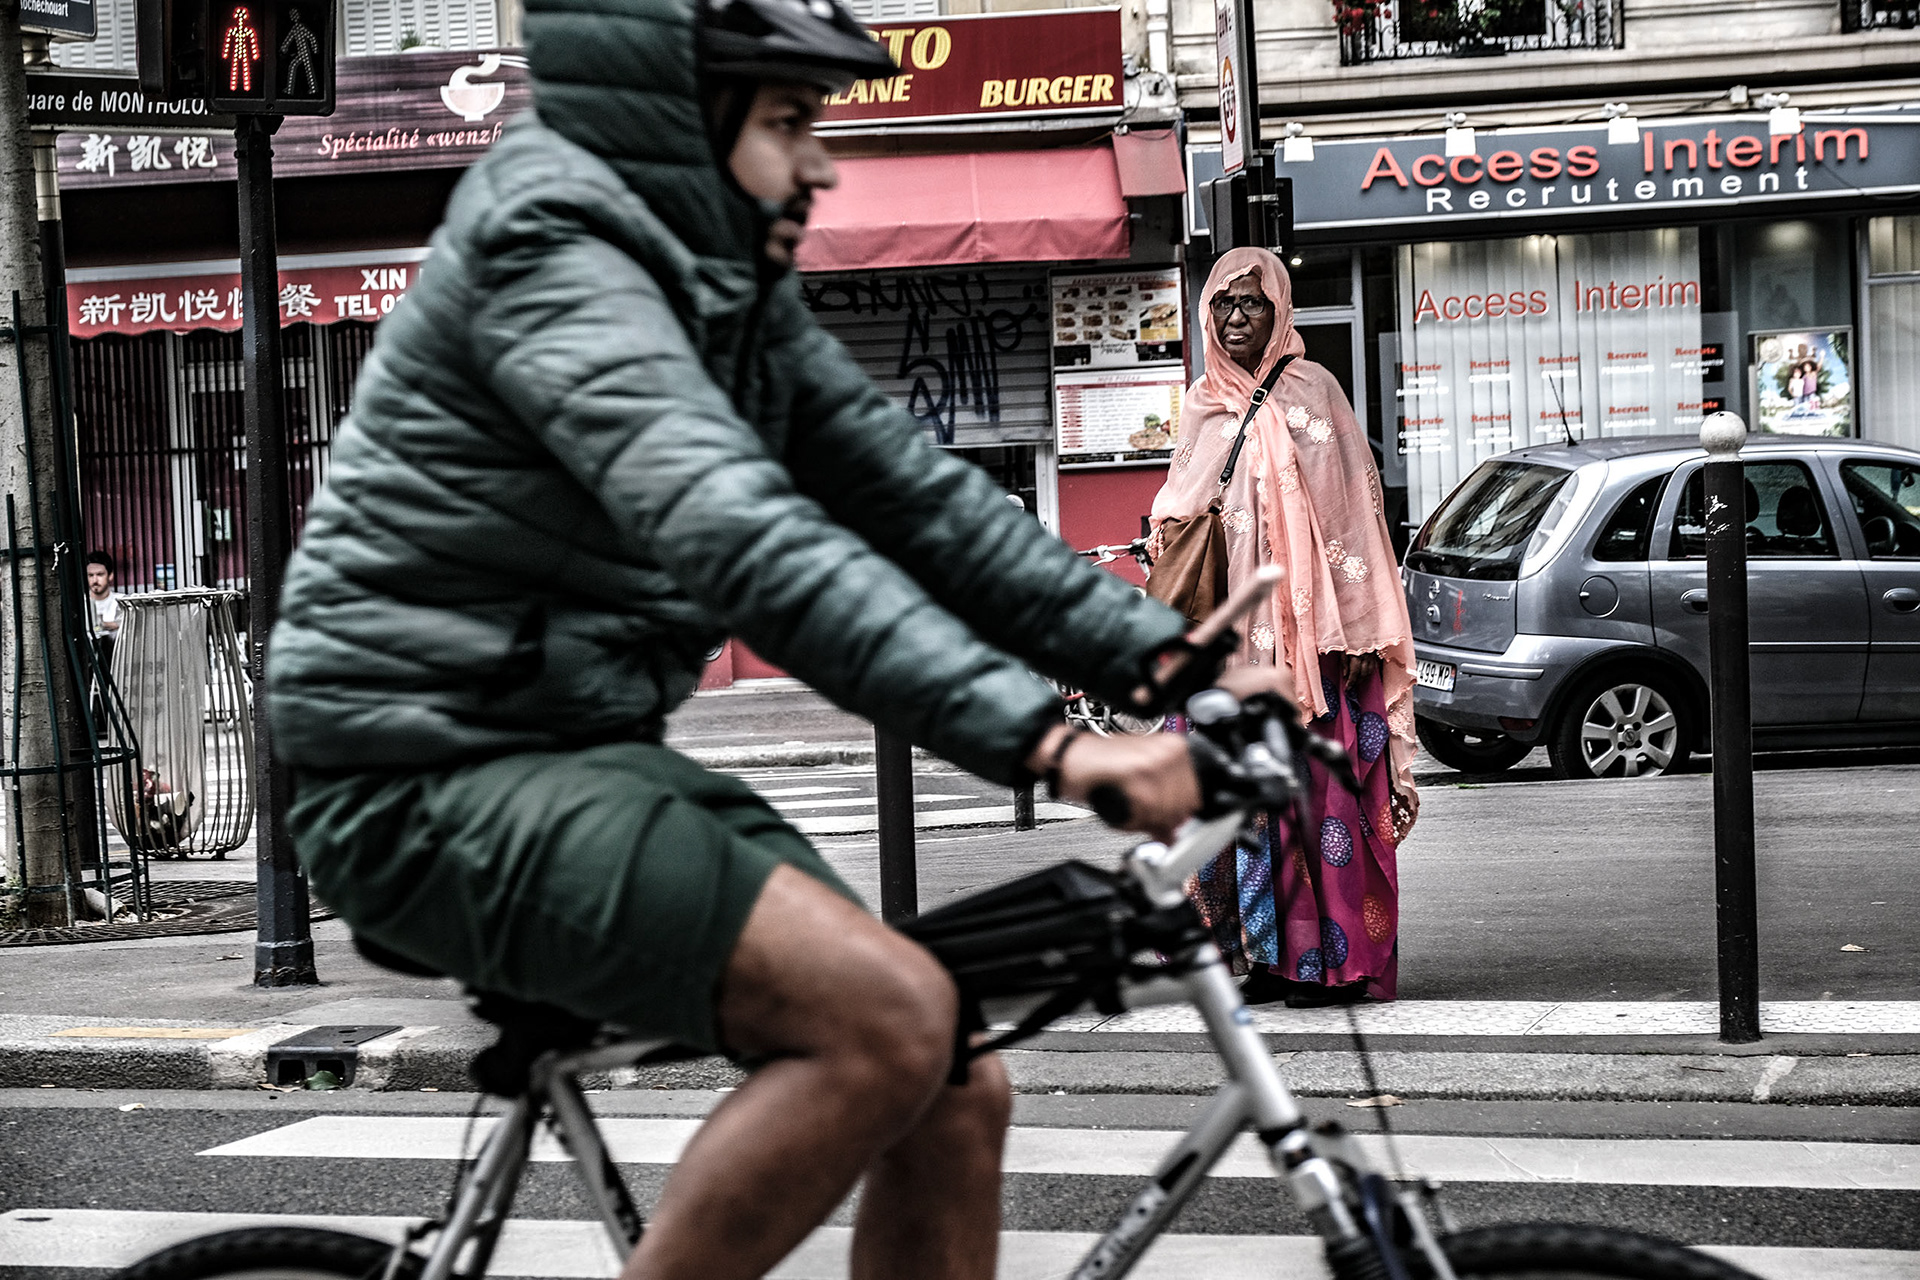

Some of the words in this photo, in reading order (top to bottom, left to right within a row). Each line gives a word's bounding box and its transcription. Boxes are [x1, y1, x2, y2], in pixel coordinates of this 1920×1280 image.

[864, 26, 952, 70] TO
[821, 74, 914, 106] LANE
[980, 73, 1115, 108] BURGER
[72, 90, 93, 111] de
[101, 91, 210, 115] MONHOLO
[317, 126, 419, 159] Spécialité
[76, 133, 218, 177] 新凯悦
[1361, 146, 1600, 190] Access
[1644, 122, 1869, 172] Interim
[1426, 165, 1809, 213] Recrutement
[361, 268, 407, 290] XIN
[334, 294, 377, 317] TEL
[1414, 289, 1549, 322] Access
[1575, 275, 1701, 312] Interim
[1607, 351, 1648, 361] Recrute
[1675, 347, 1716, 356] Recrute
[1401, 363, 1442, 372] Recrute
[1470, 360, 1511, 370] Recrute
[1538, 356, 1580, 365] Recrute
[1608, 405, 1650, 414] Recrute
[1677, 400, 1719, 410] Recrute
[1404, 416, 1444, 426] Recrute
[1471, 414, 1512, 423] Recrute
[1540, 410, 1582, 420] Recrute
